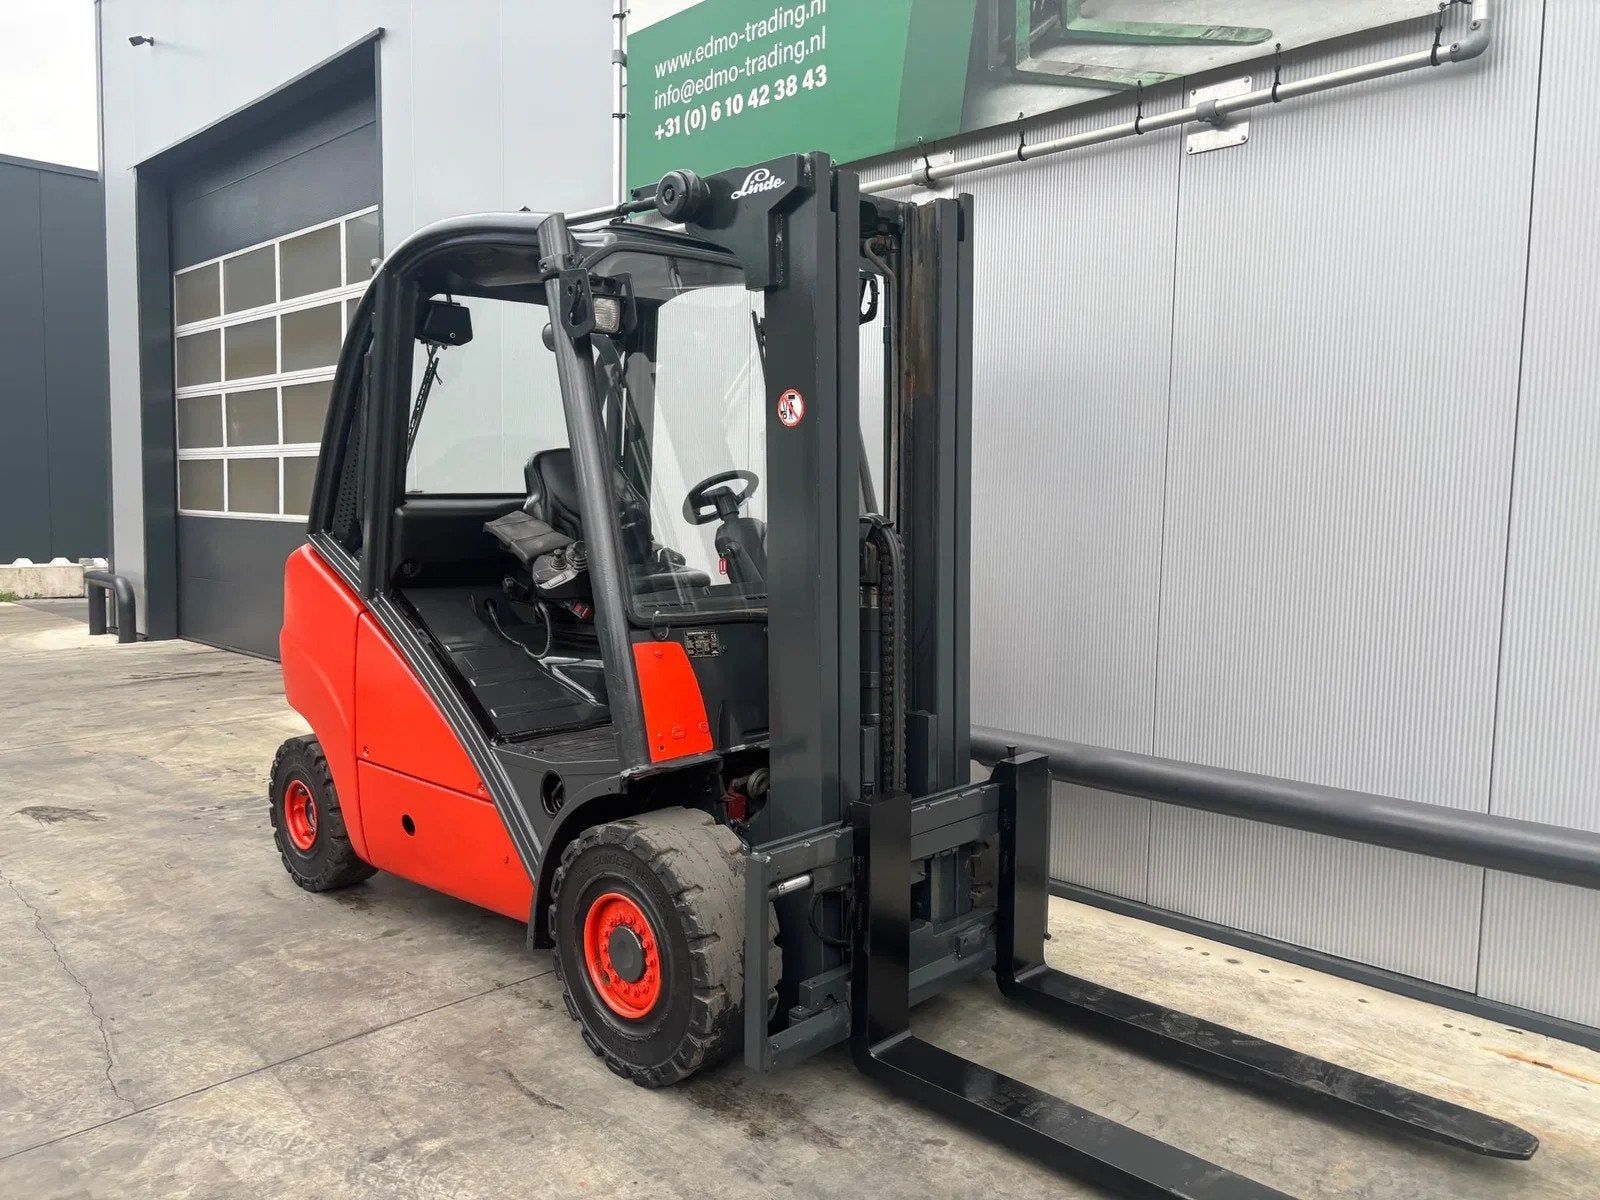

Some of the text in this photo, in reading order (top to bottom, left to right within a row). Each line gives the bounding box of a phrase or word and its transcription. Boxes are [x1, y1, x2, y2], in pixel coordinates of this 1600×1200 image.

[654, 25, 826, 110] info@edmo-trading.nl
[654, 64, 827, 140] +31 (0) 6 10 42 38 43
[730, 168, 785, 200] Linde
